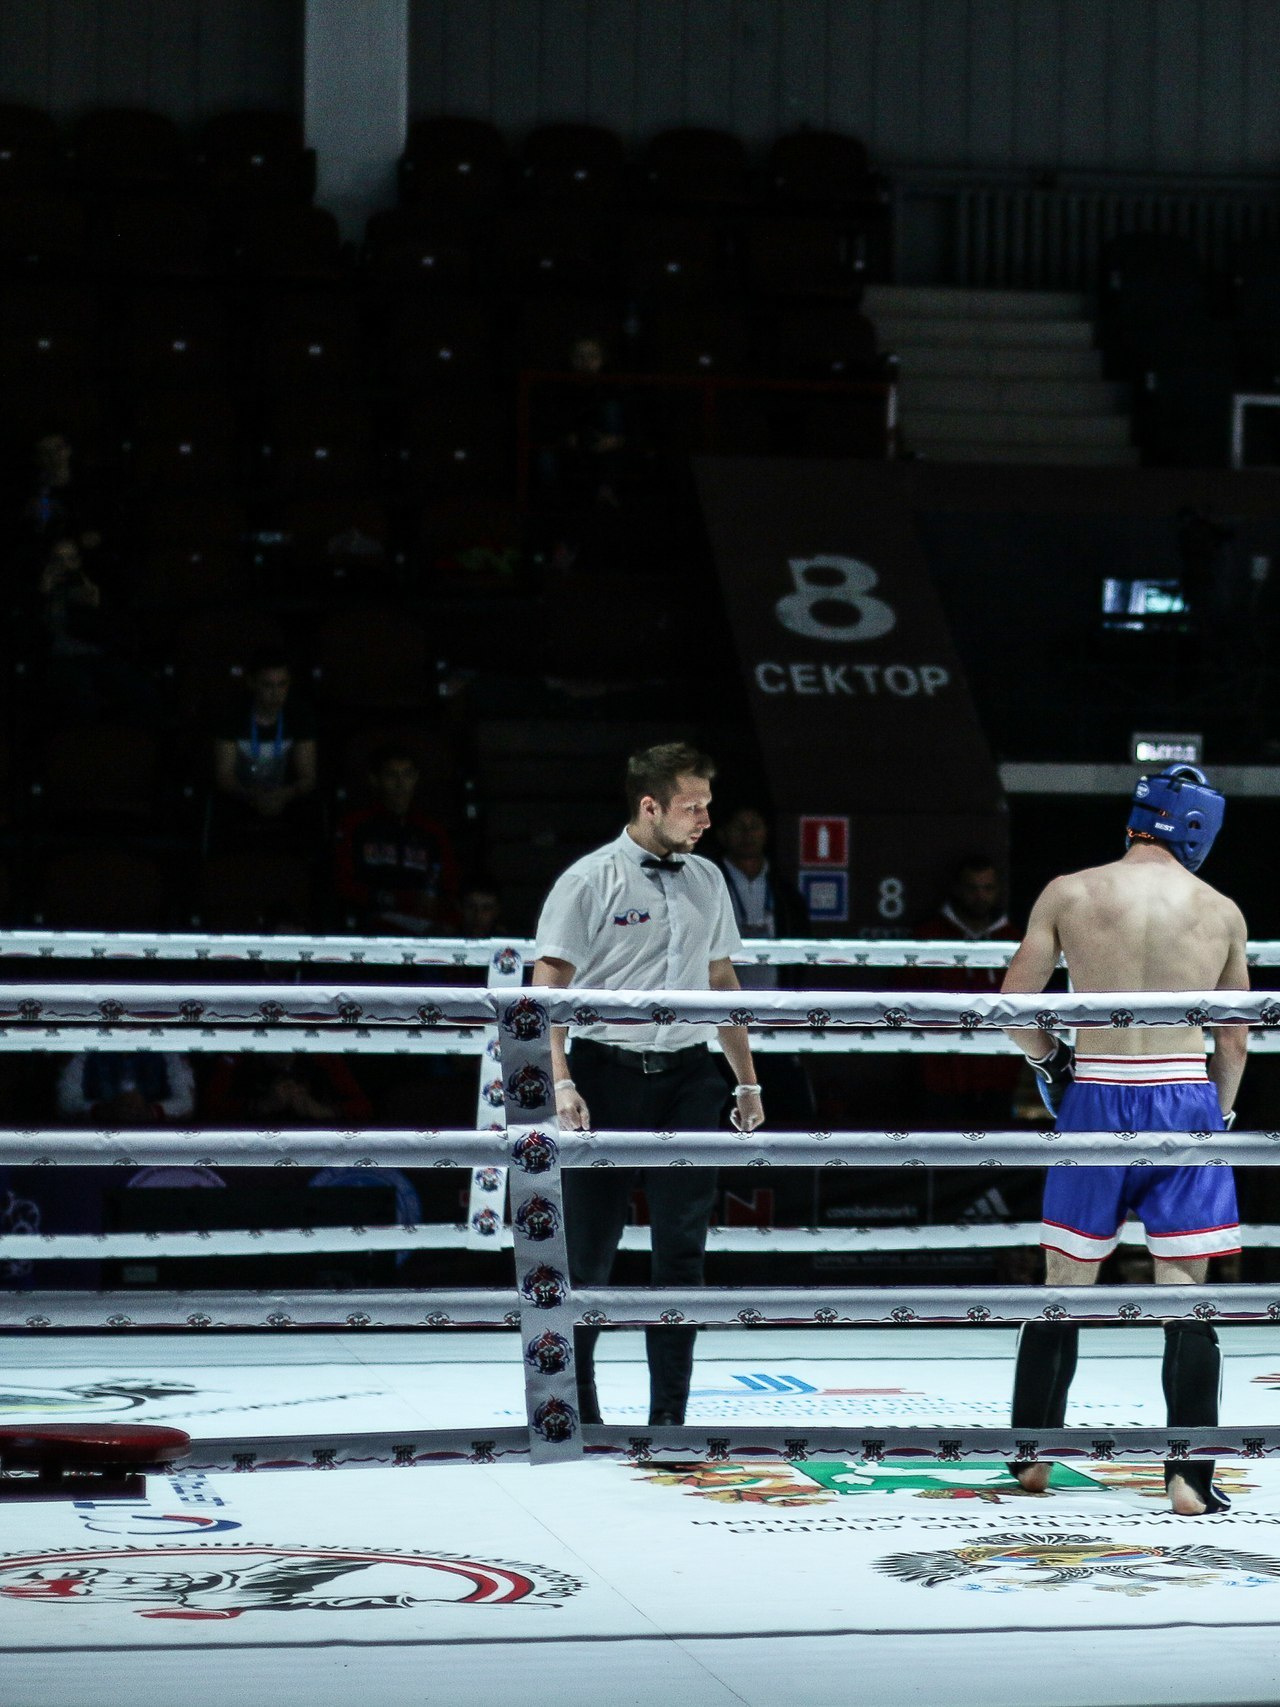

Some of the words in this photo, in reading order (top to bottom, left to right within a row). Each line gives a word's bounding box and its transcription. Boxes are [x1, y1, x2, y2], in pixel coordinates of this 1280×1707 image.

[775, 554, 897, 642] 8
[754, 662, 950, 697] СЕКТОР
[877, 877, 904, 919] 8
[728, 1524, 903, 1535] спорта
